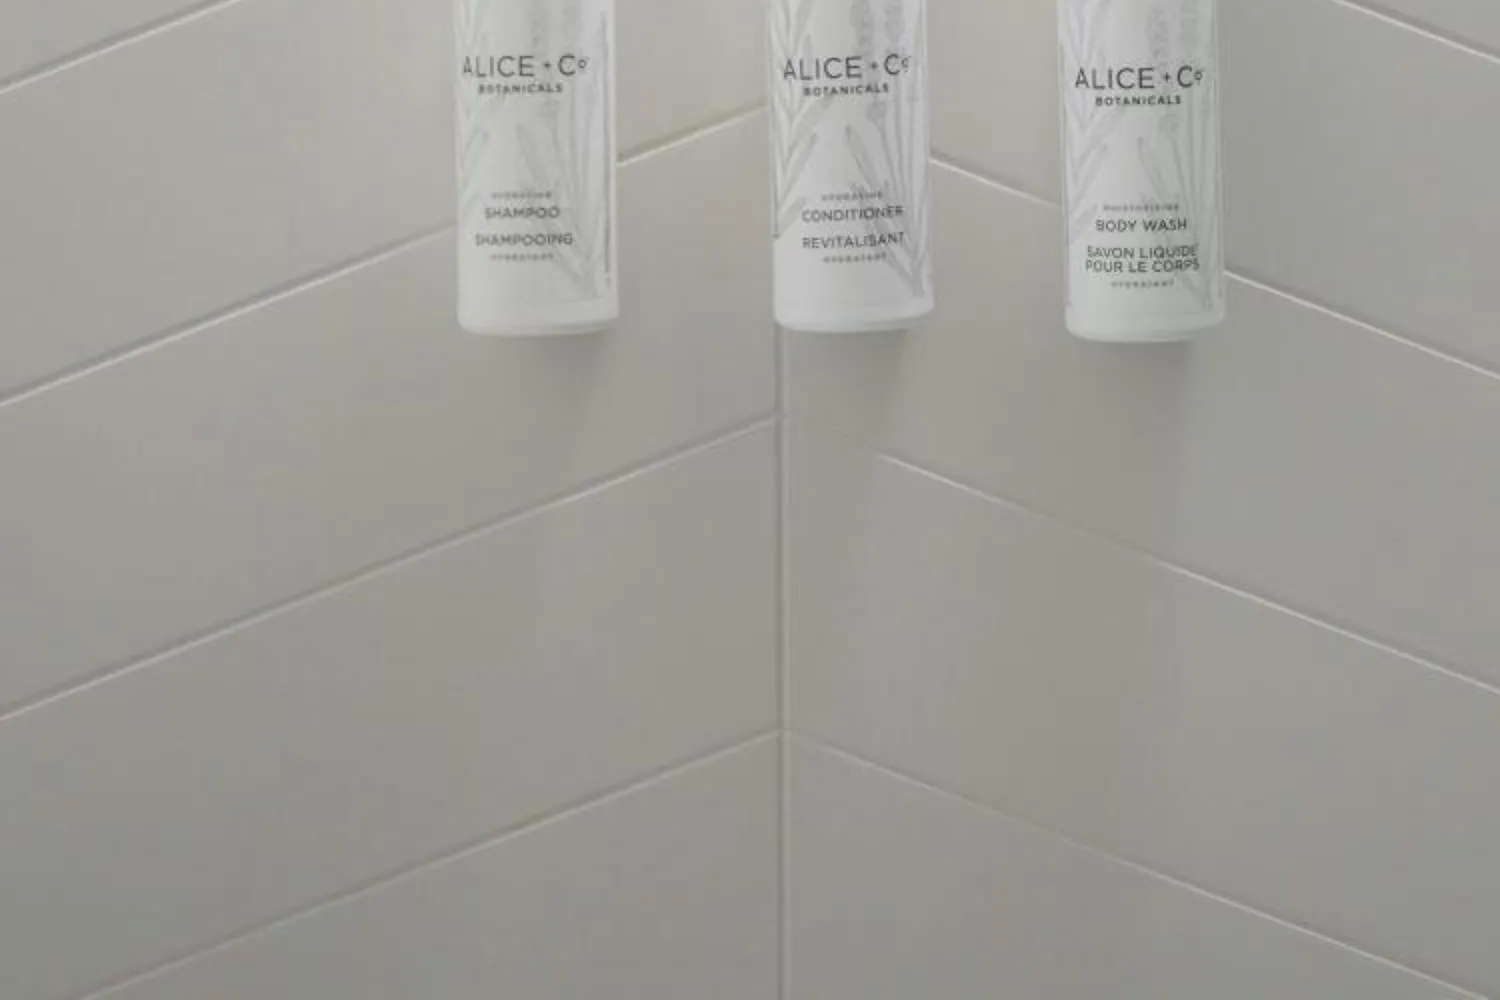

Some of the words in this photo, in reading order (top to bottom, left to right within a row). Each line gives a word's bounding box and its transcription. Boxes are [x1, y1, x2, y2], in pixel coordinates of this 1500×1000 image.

[462, 55, 535, 78] ALICE
[783, 55, 863, 81] ALICE
[1075, 66, 1156, 90] ALICE
[478, 83, 563, 95] BOTANICALS
[803, 82, 889, 97] BOTANICALS
[1095, 94, 1182, 106] BOTANICALS
[484, 205, 561, 219] SHAMPOO
[801, 204, 904, 222] CONDITIONER
[1095, 219, 1137, 232] BODY
[1142, 217, 1188, 232] WASH
[801, 231, 904, 249] REVITALISANT
[1086, 245, 1136, 259] SAVON
[1139, 243, 1198, 259] LIQUIDE
[1085, 259, 1123, 273] POUR
[1128, 260, 1148, 273] LE
[1151, 257, 1201, 273] CORPS
